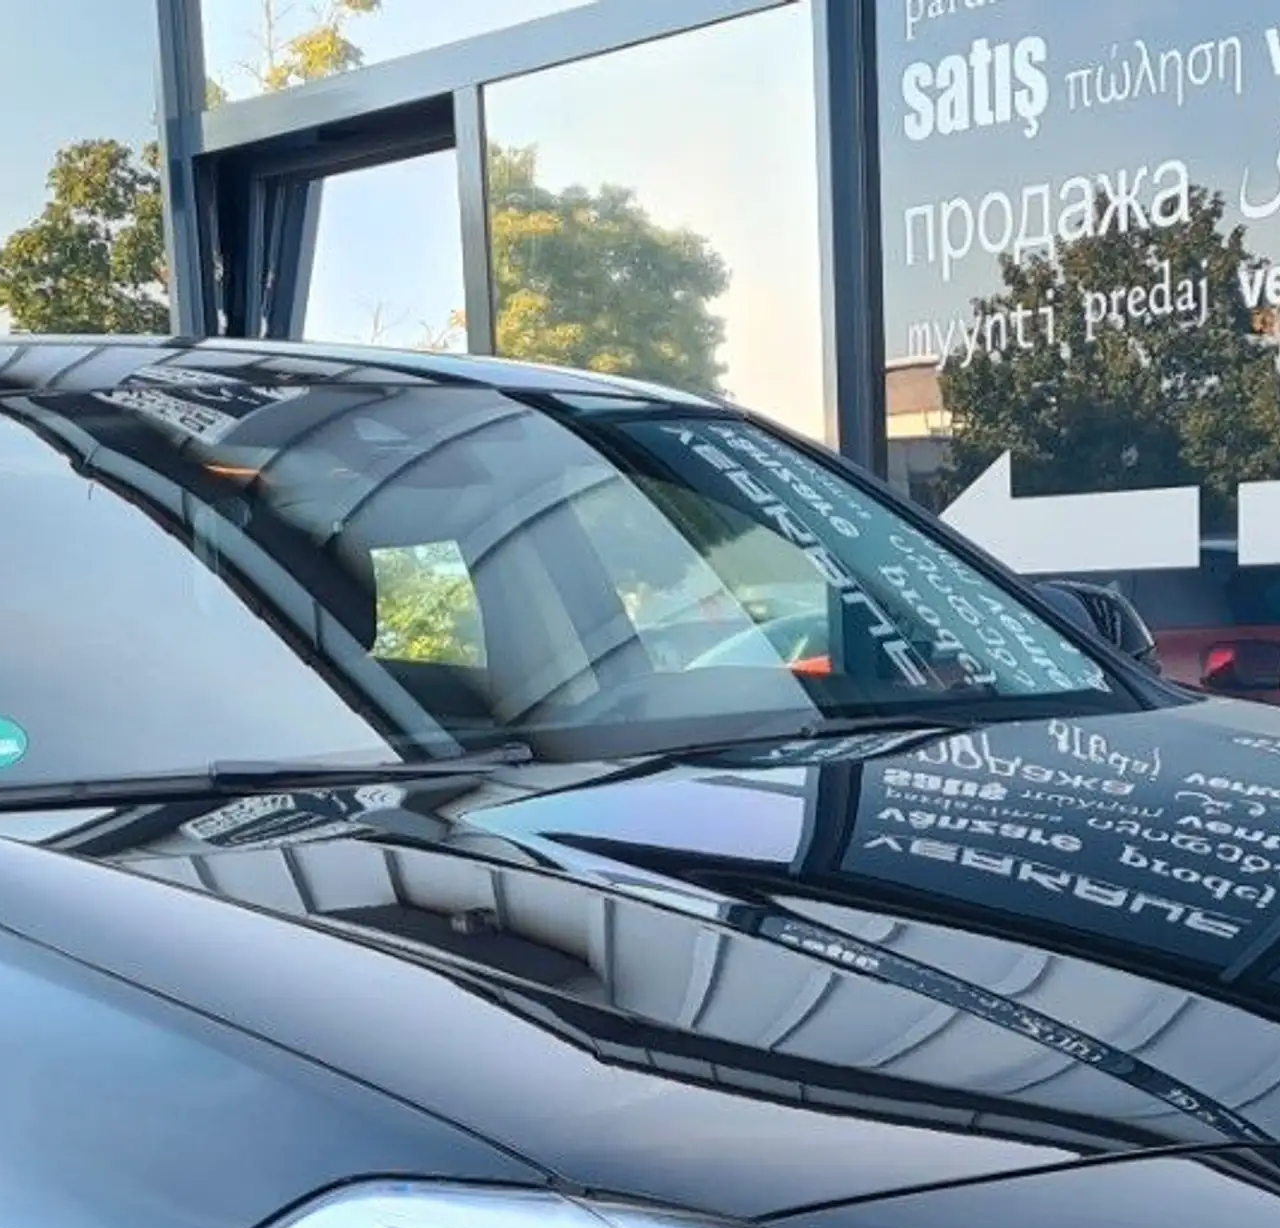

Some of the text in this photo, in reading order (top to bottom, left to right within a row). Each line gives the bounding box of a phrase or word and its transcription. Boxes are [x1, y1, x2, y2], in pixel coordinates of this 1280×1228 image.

[902, 36, 1048, 140] satış
[1064, 36, 1242, 109] πώληση
[905, 158, 1191, 281] продажа
[906, 289, 1060, 371] myynti
[1085, 260, 1211, 342] predaj
